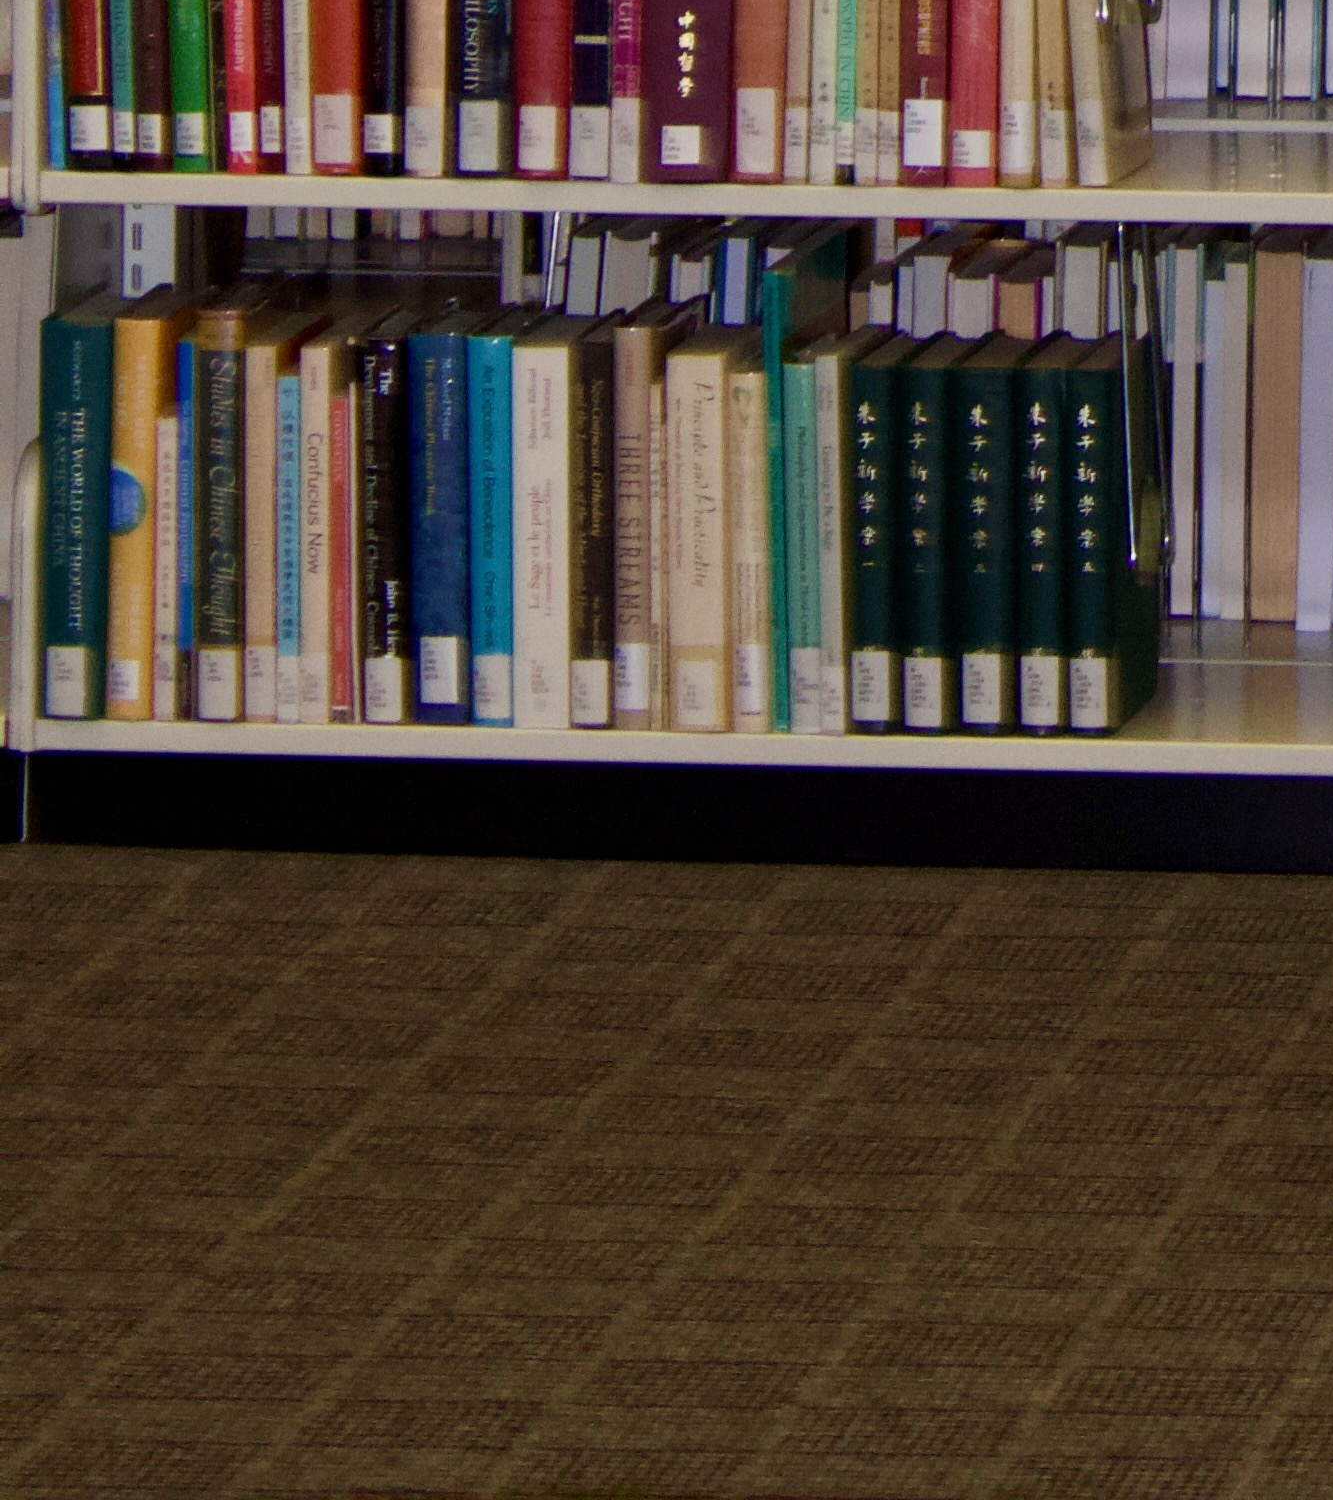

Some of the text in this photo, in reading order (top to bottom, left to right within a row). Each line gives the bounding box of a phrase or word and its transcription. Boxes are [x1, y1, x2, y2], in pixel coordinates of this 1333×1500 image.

[230, 1, 245, 73] Philosophy
[68, 408, 85, 632] THE WORLD OF THOUGHT
[307, 433, 323, 575] Confucius Now
[480, 365, 496, 559] An Exposition of Benevolence
[618, 435, 640, 625] THREE STREAMS
